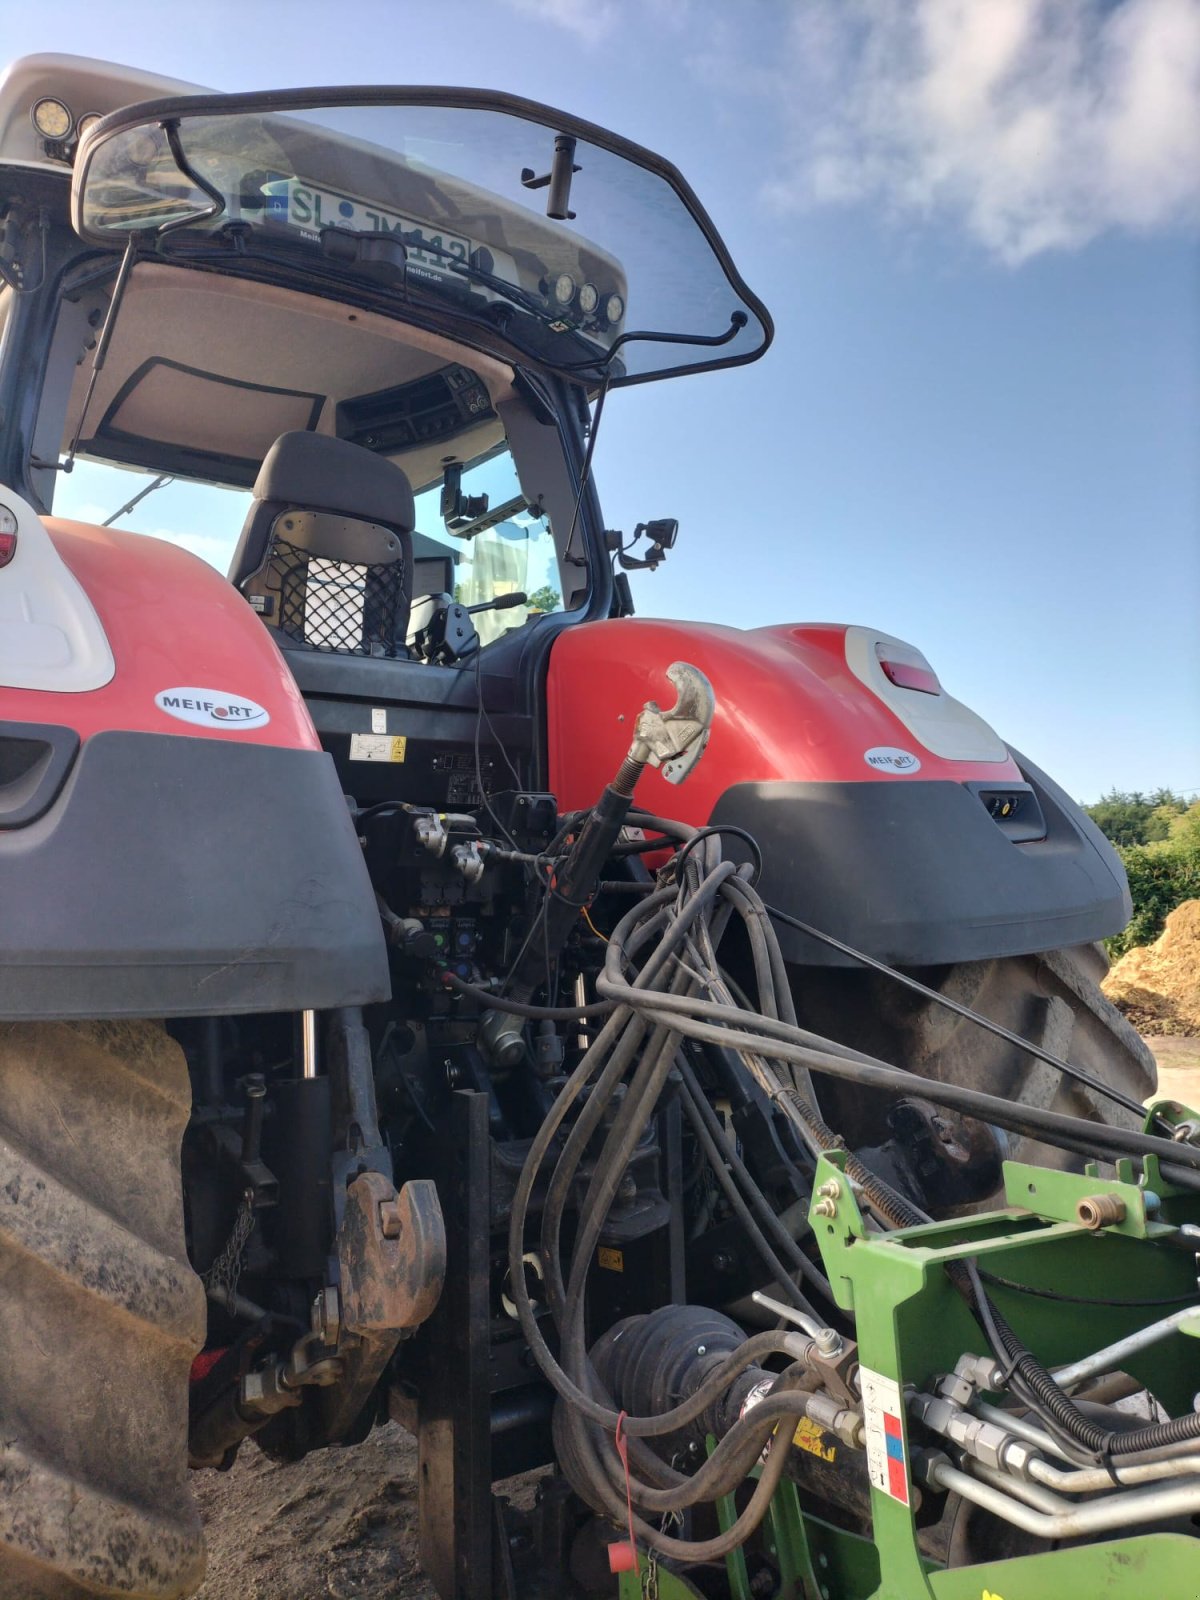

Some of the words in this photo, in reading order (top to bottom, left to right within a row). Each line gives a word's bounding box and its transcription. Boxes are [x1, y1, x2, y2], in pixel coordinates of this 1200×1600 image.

[273, 201, 282, 213] D
[291, 187, 335, 229] SL
[162, 695, 253, 719] MEIFORT
[868, 756, 912, 767] MEIFORT
